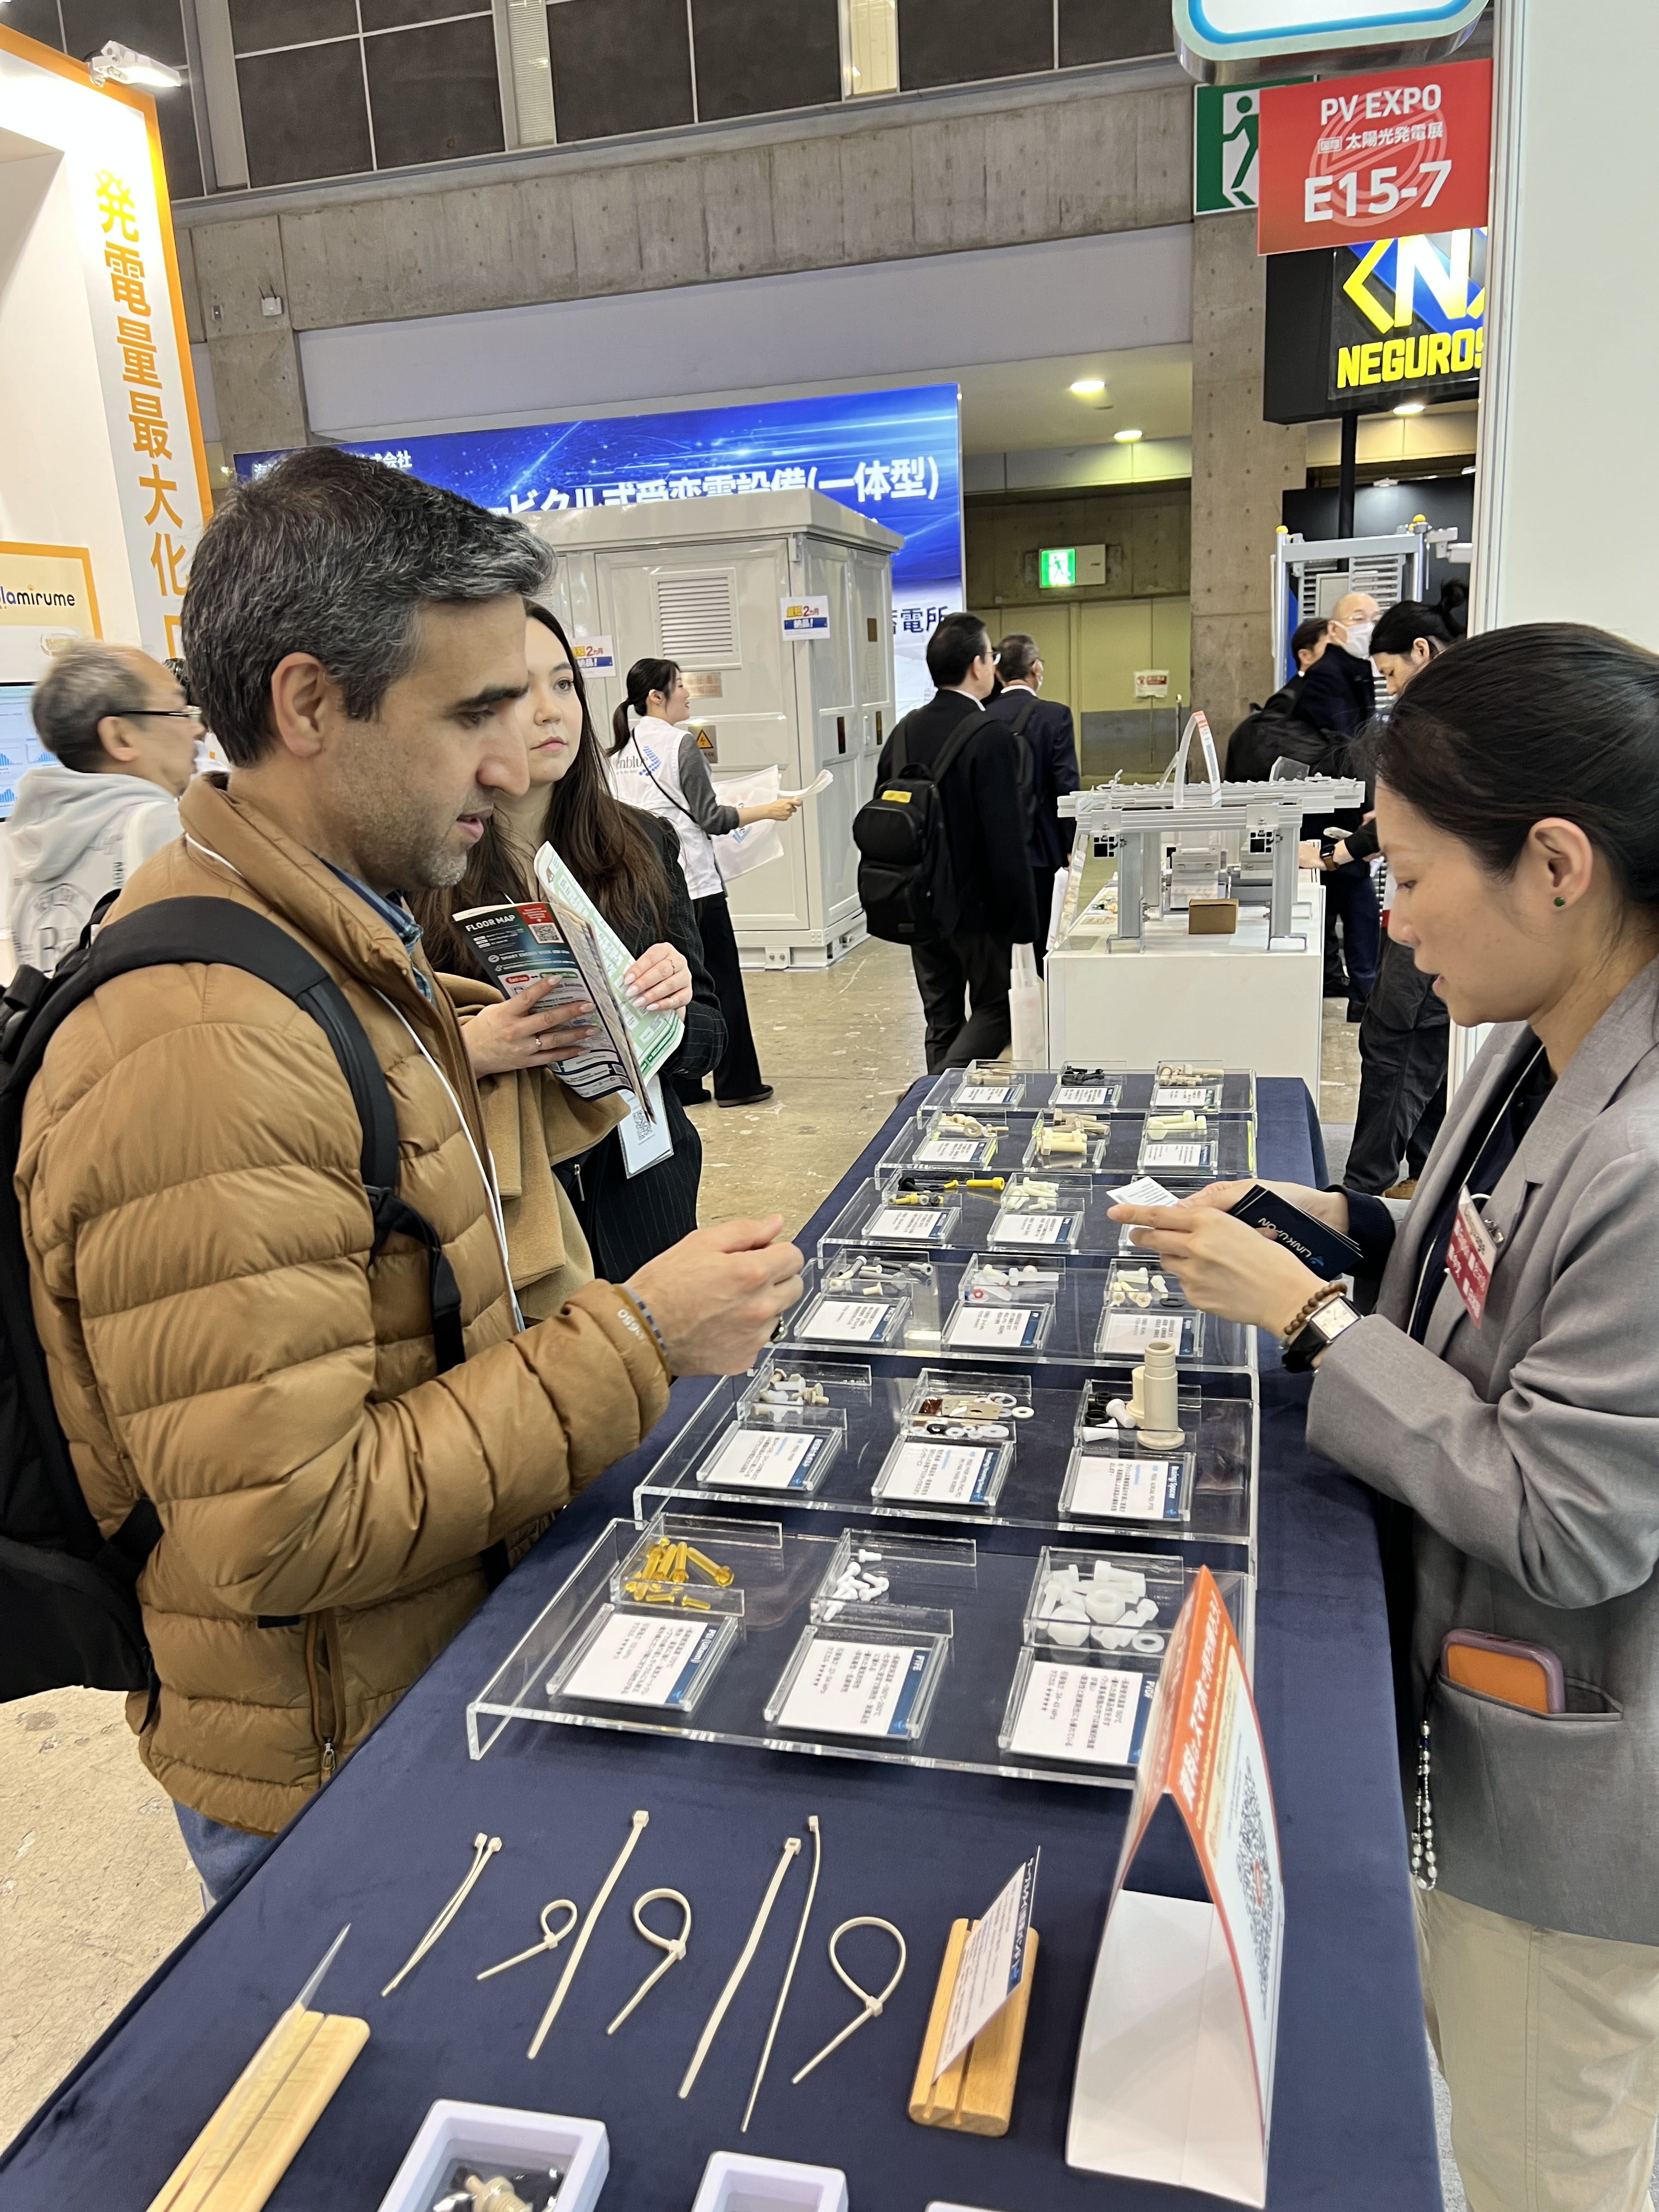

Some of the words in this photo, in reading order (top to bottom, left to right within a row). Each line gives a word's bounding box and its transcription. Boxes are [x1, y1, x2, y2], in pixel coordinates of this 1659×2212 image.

[1320, 95, 1359, 126] PV
[1365, 84, 1442, 119] EXPO
[1346, 121, 1444, 150] 太陽光発電展
[1304, 160, 1452, 223] E15-7
[95, 167, 189, 657] 発電量最大化
[0, 585, 76, 607] lamirume
[465, 919, 496, 932] FLOOR
[496, 915, 516, 924] MAP
[911, 1654, 926, 1671] PTFE
[1141, 1680, 1157, 1699] PVDF
